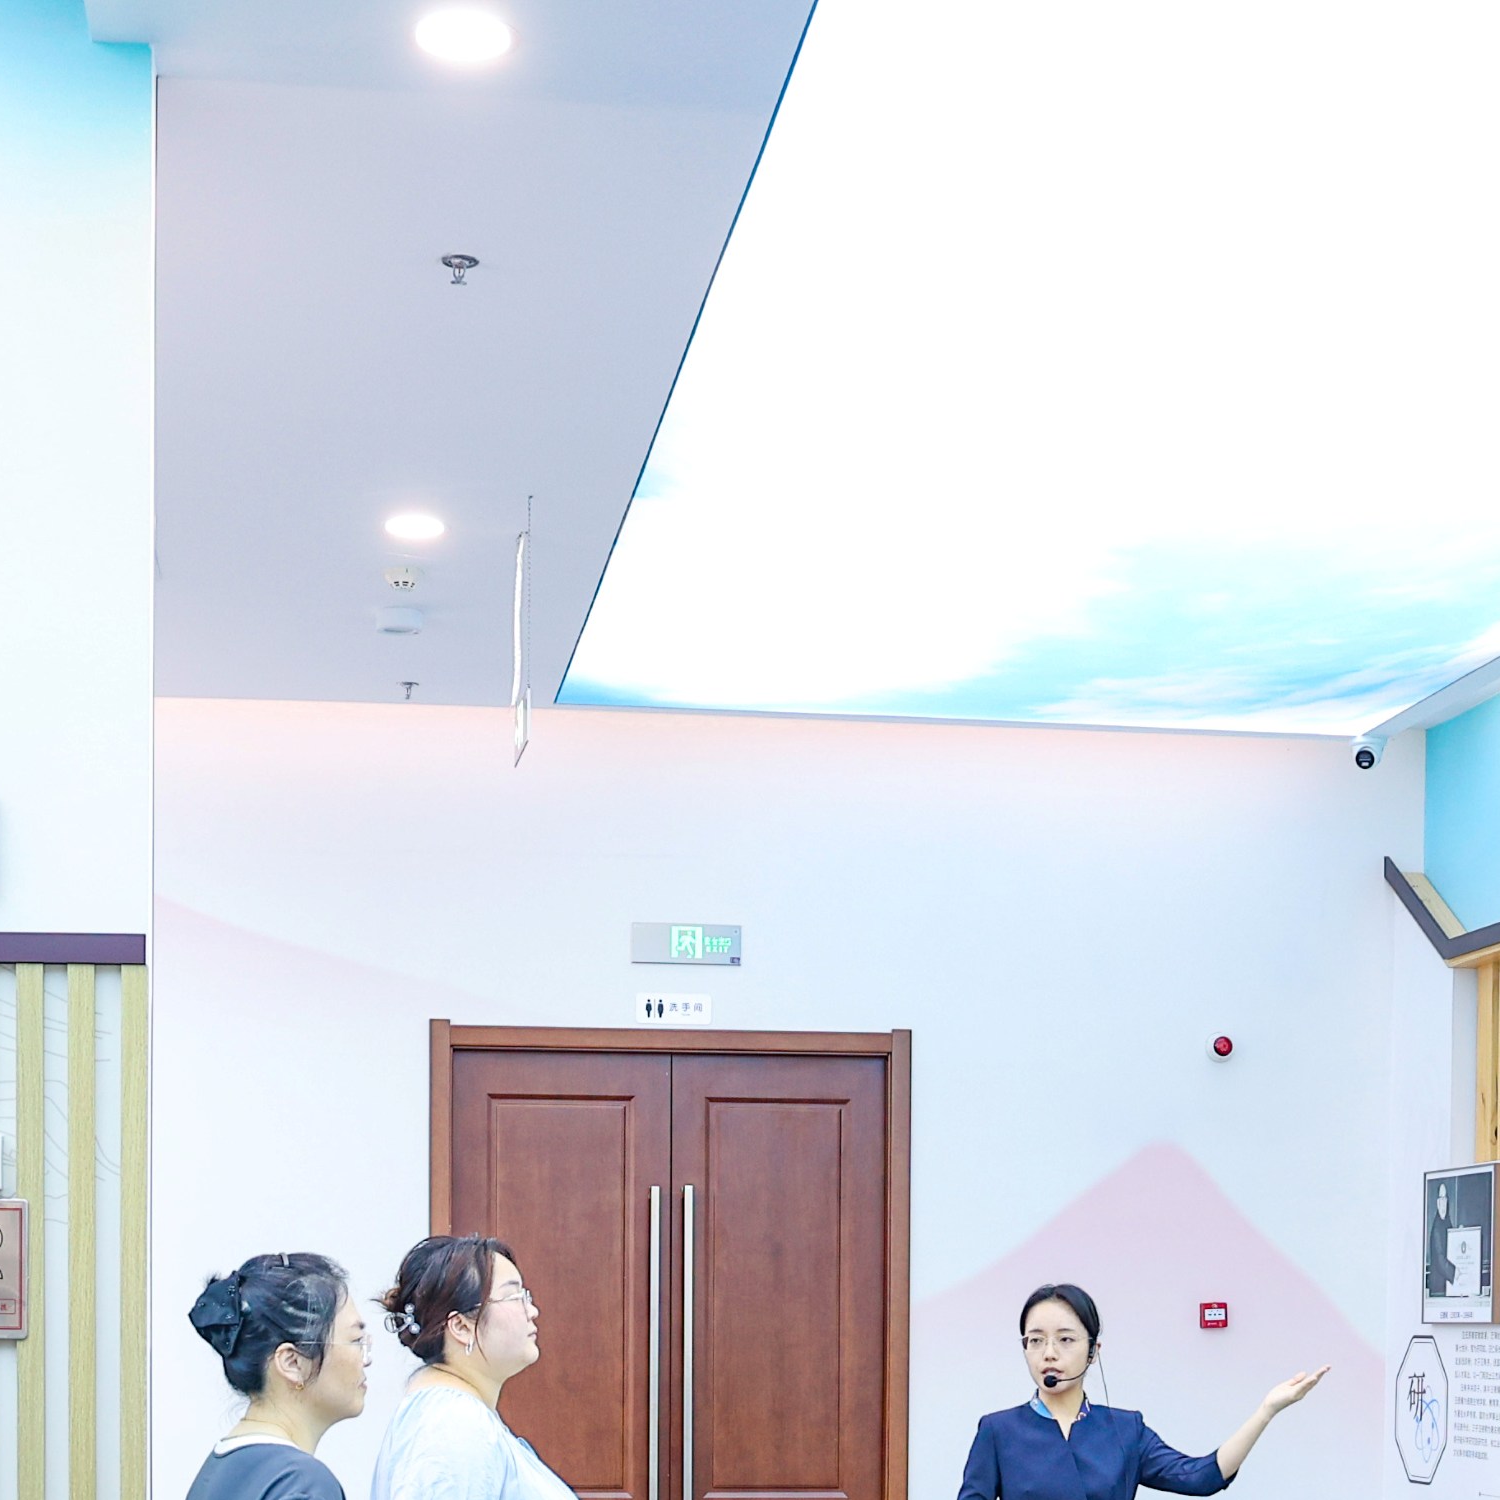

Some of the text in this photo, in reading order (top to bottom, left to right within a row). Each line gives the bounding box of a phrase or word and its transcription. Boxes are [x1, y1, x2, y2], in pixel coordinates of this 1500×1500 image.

[669, 1002, 703, 1012] 洗手间
[1407, 1368, 1428, 1419] 研
